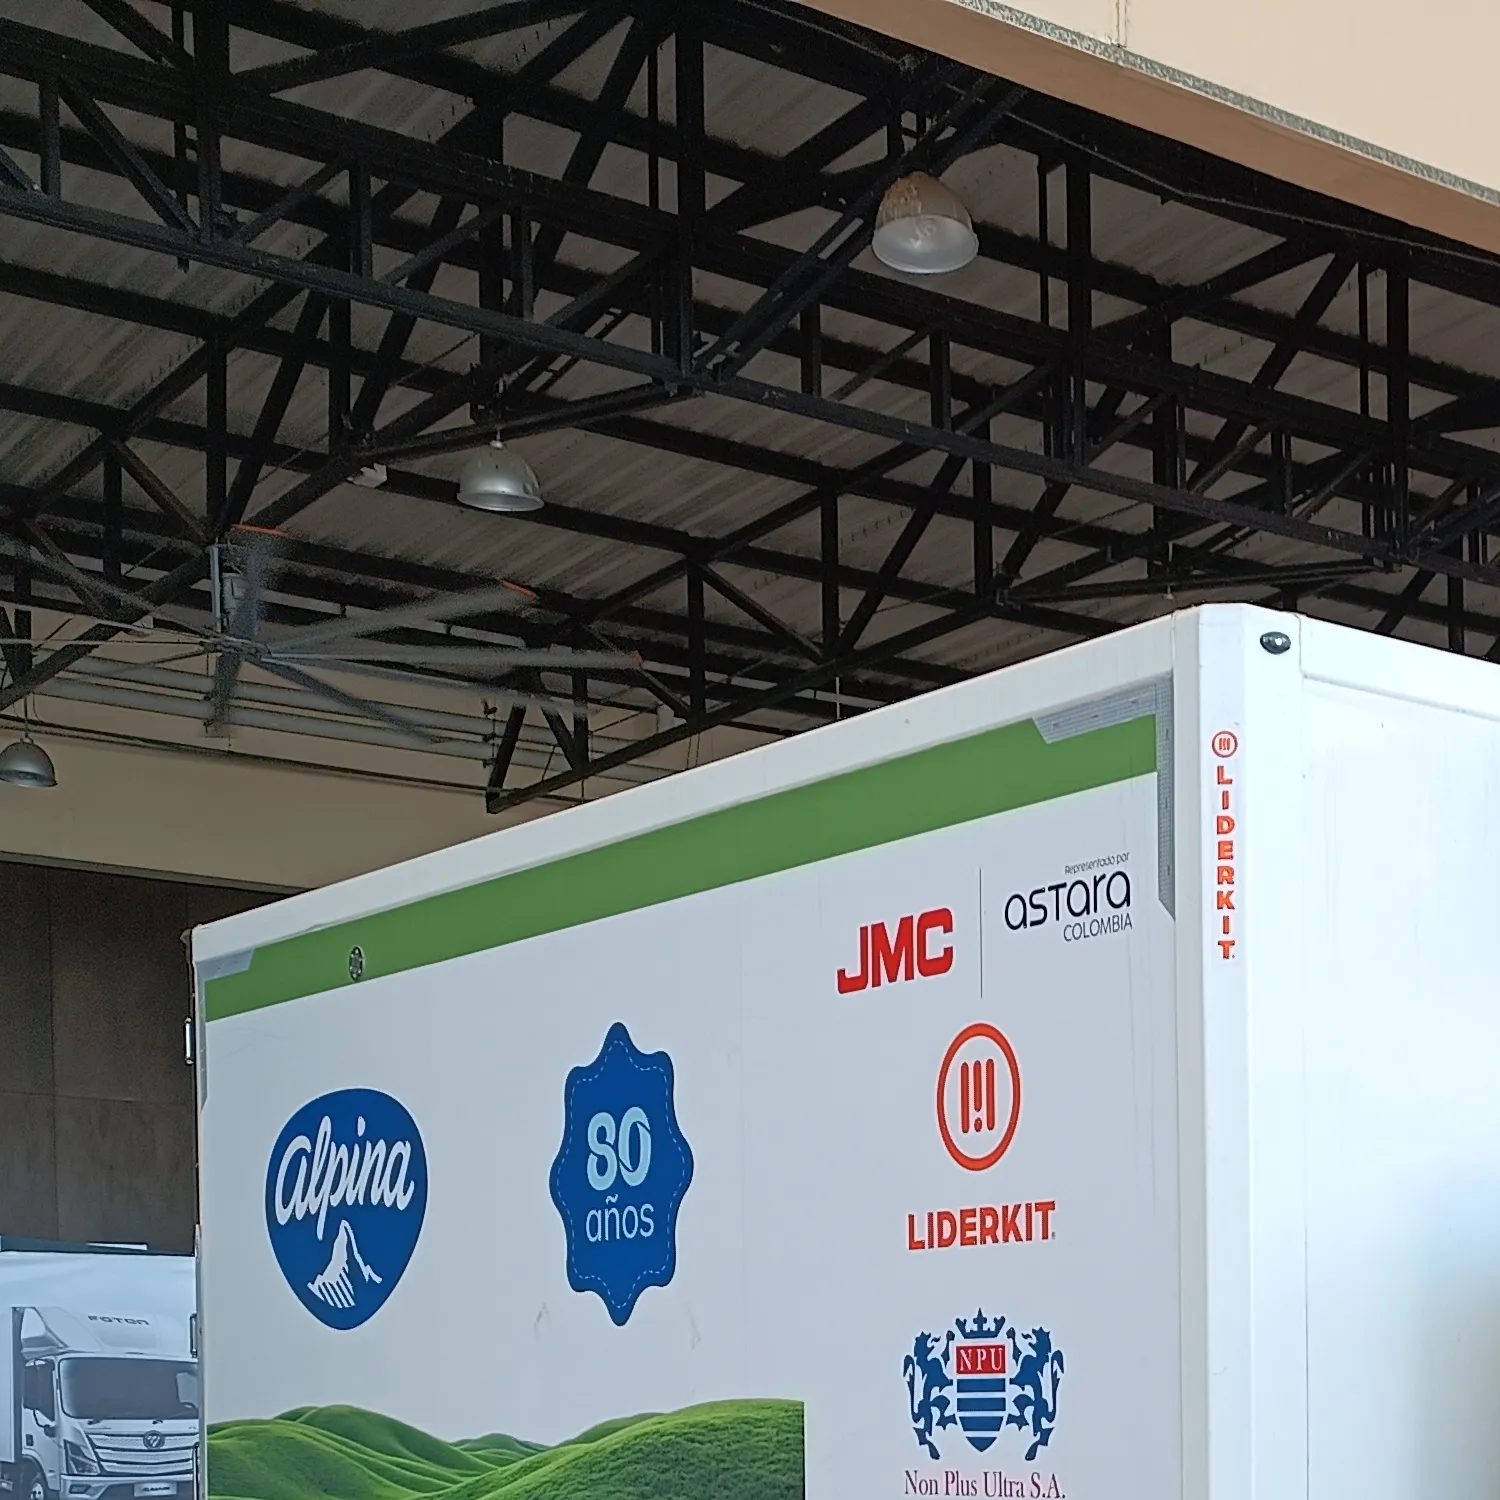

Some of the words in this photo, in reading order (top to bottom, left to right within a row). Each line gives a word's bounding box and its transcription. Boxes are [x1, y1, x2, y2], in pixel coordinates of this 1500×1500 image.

[1216, 765, 1236, 960] LIDERKIT
[836, 907, 954, 995] JMC
[1063, 912, 1133, 942] COLOMBIA
[586, 1106, 652, 1191] 80
[274, 1114, 415, 1241] alpina
[585, 1193, 656, 1243] años
[906, 1199, 1057, 1251] LIDERKIT
[958, 1346, 1005, 1373] NPU
[904, 1469, 939, 1496] Non
[944, 1470, 978, 1497] Plus
[983, 1471, 1025, 1498] Ultra
[1030, 1471, 1066, 1499] S.A.
